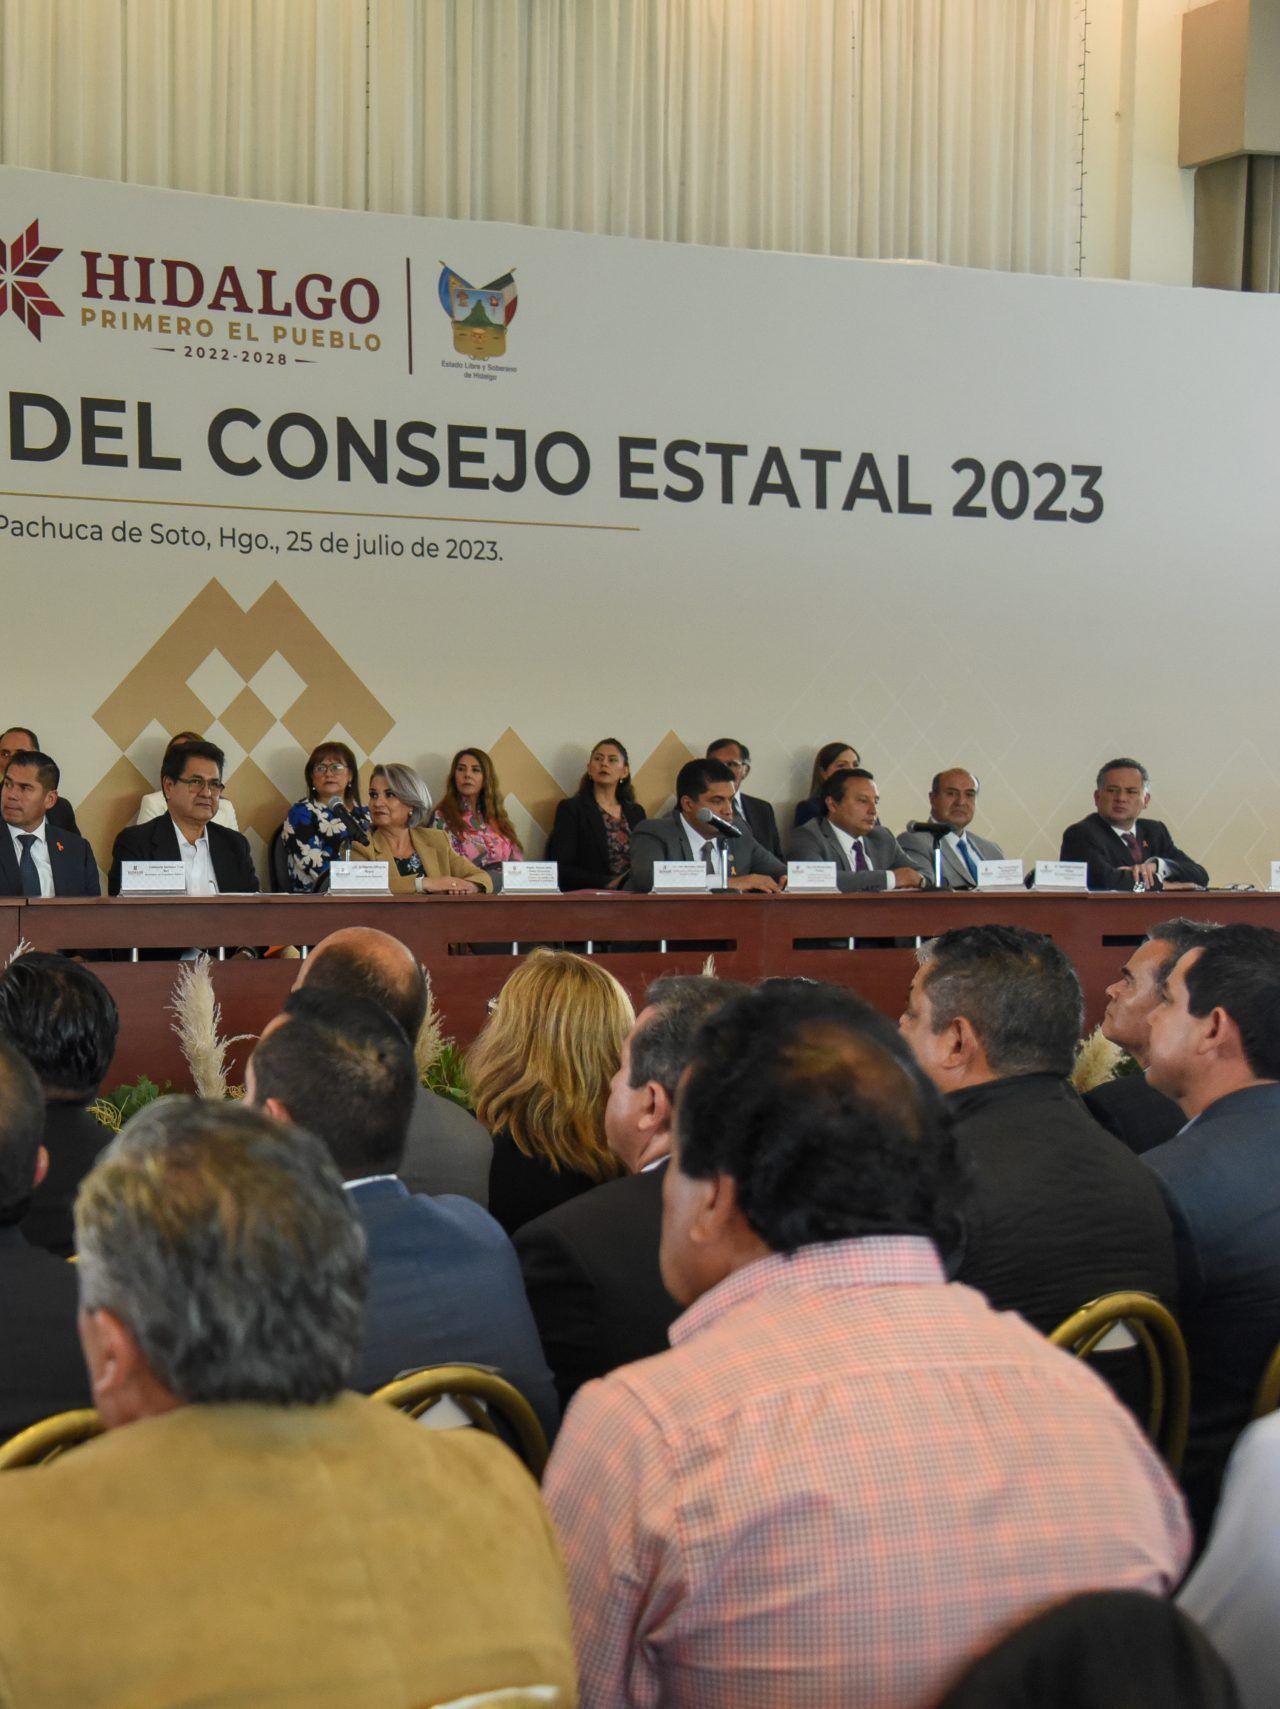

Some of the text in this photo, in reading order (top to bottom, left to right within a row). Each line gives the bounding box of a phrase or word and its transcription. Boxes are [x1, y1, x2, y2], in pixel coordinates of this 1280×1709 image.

[80, 250, 381, 325] HIDALGO
[80, 306, 382, 352] PRIMERO EL PUEBLO
[183, 345, 288, 366] 2022-2028
[441, 360, 463, 369] Estado
[464, 362, 481, 370] Libre
[487, 364, 517, 373] Soberano
[473, 372, 497, 381] Hidalgo
[8, 391, 182, 472] DEL
[207, 407, 591, 496] CONSEJO
[618, 436, 932, 515] ESTATAL
[951, 457, 1104, 524] 2023
[111, 520, 143, 544] de
[150, 522, 211, 551] Soto,
[219, 526, 281, 555] Hgo.,
[286, 530, 313, 553] 25
[319, 531, 349, 554] de
[353, 532, 405, 560] julio
[411, 536, 440, 559] de
[445, 538, 504, 562] 2023.
